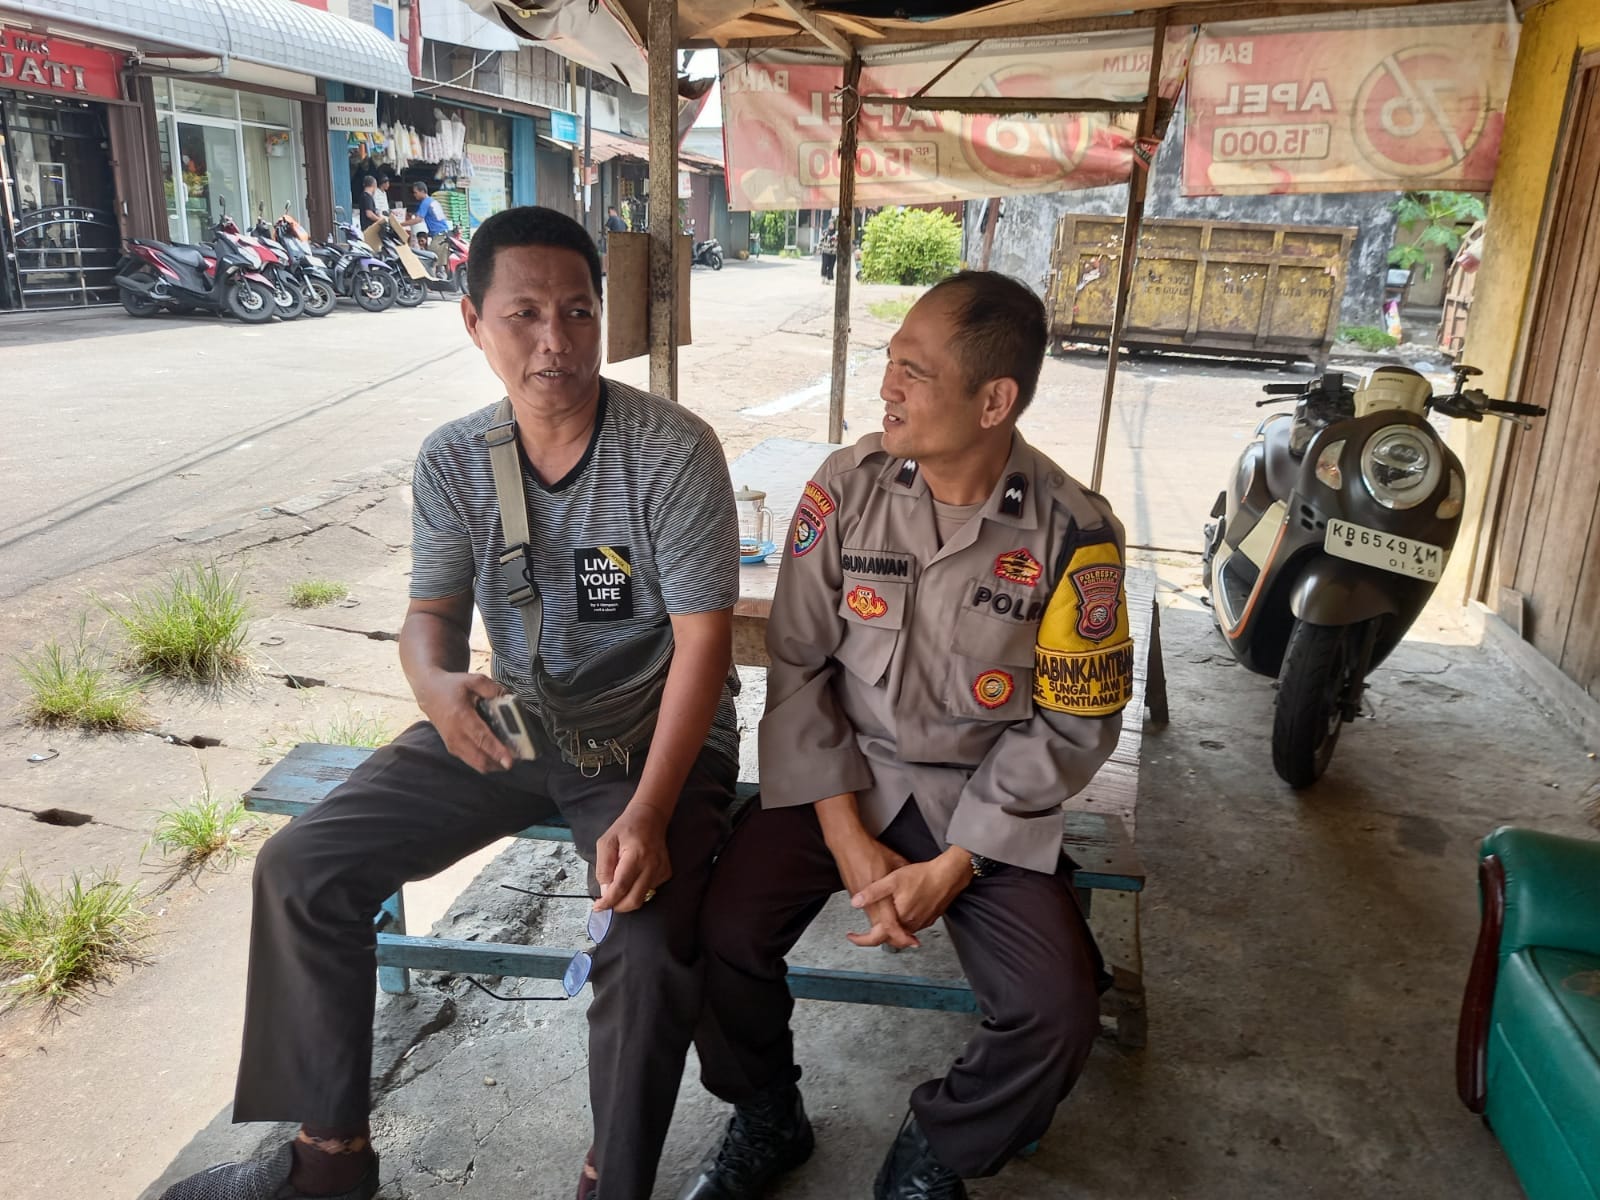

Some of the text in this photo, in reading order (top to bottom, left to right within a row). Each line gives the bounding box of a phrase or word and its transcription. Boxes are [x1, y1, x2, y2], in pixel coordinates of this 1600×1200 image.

[330, 116, 374, 128] MULIA INDAH
[1333, 523, 1438, 563] KB 6549 XM
[584, 558, 620, 571] LIVE
[579, 572, 626, 586] YOUR
[588, 588, 621, 600] LIFE
[1049, 681, 1091, 696] SUNGAI
[1054, 692, 1121, 706] PONTIANAK
